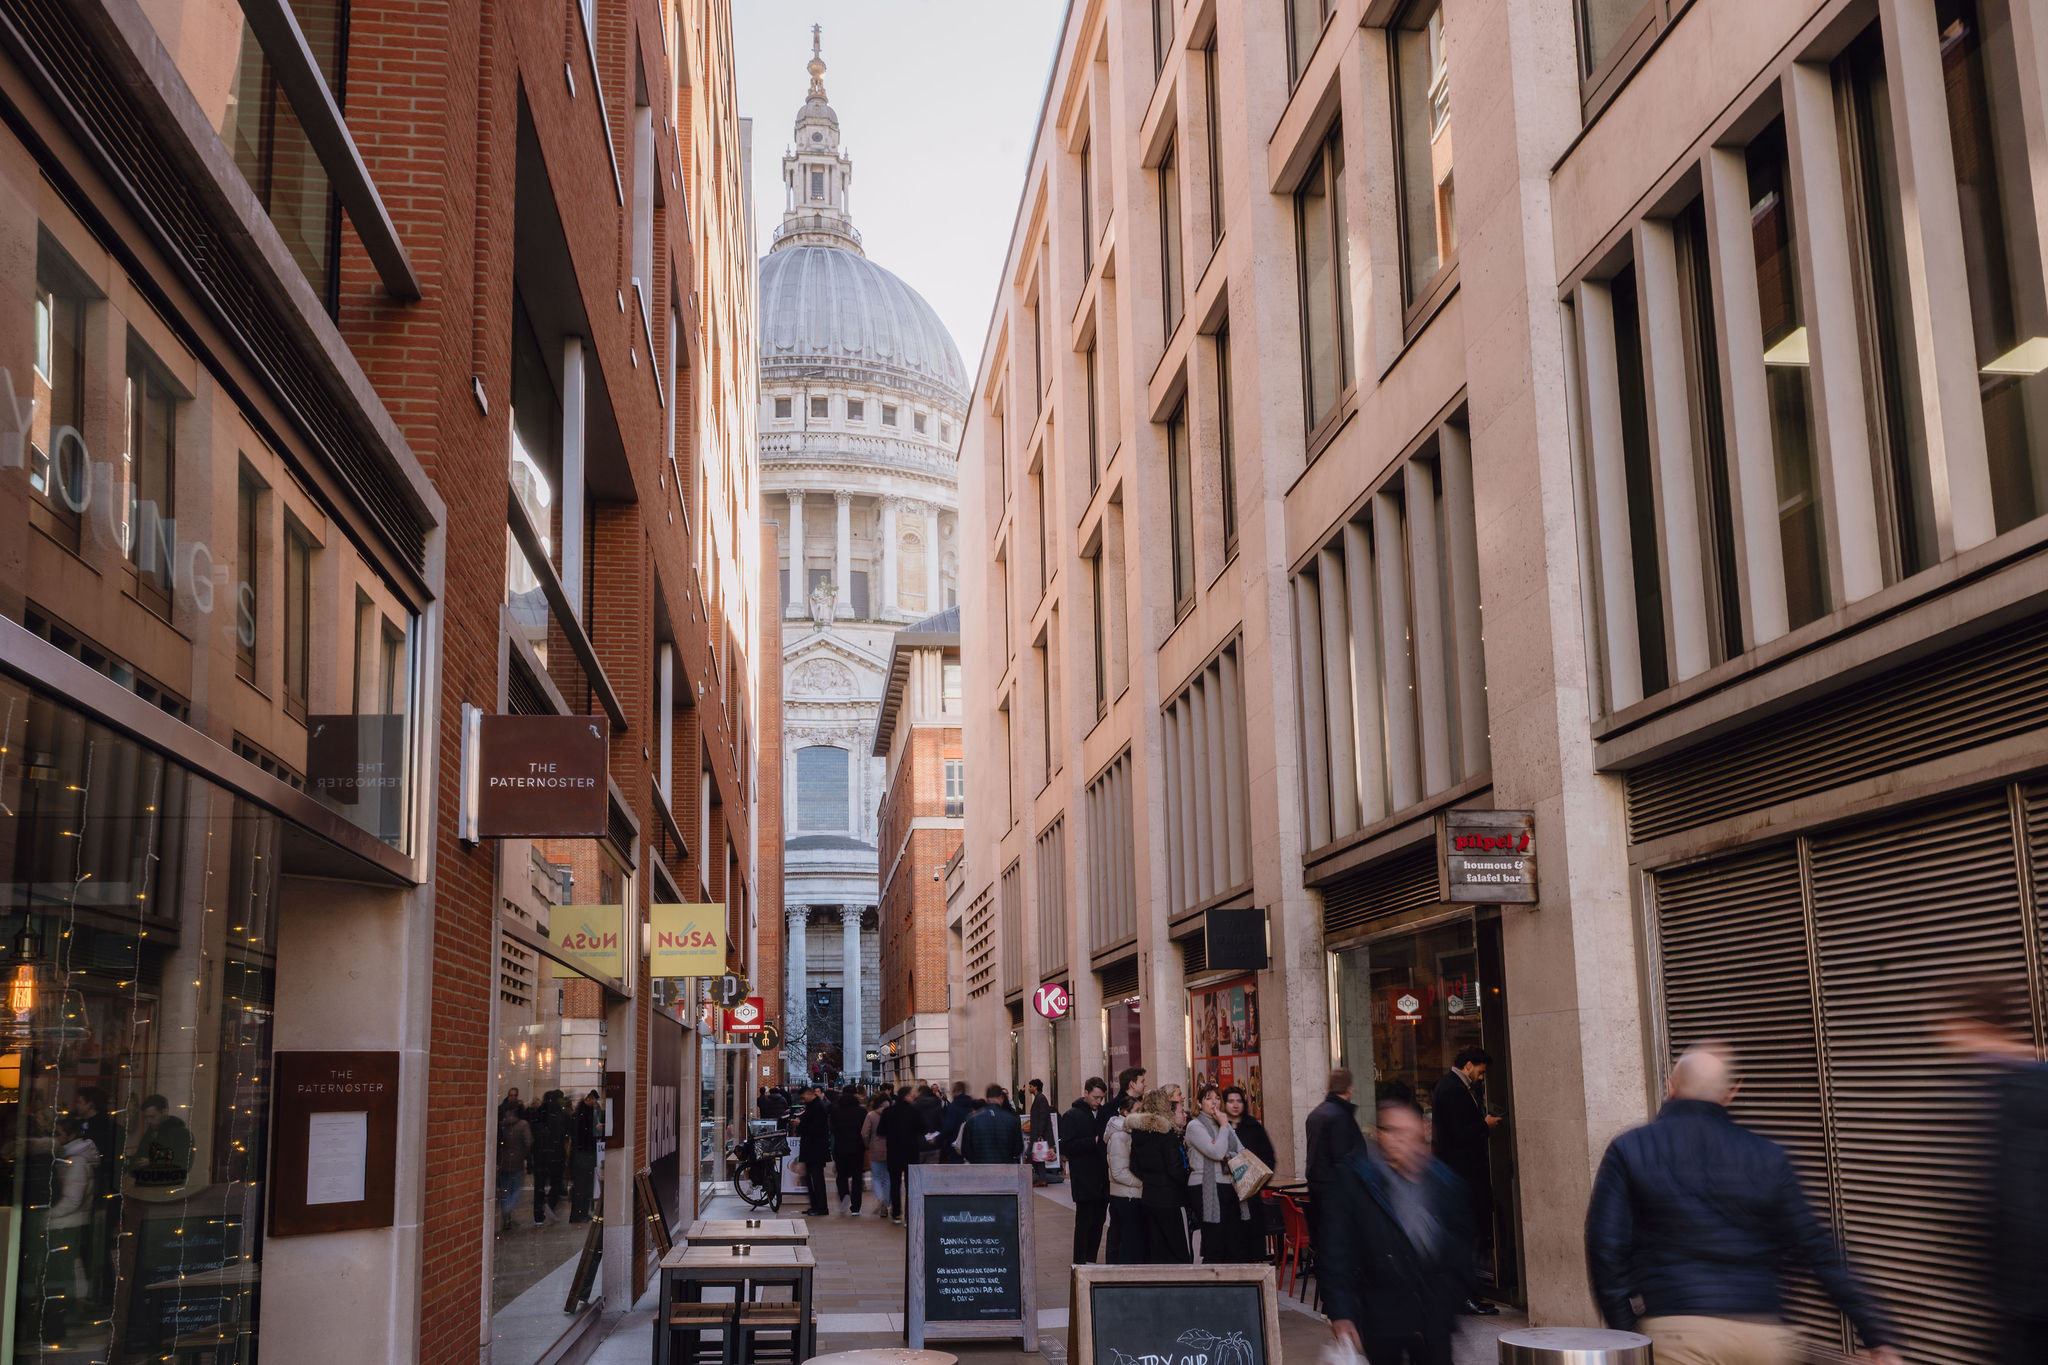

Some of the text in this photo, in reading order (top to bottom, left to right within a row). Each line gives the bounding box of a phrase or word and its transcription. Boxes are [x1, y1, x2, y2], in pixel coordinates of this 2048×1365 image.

[529, 763, 557, 773] THE
[490, 777, 595, 788] PATERNOSTER
[1455, 833, 1513, 851] pilpel
[1463, 861, 1524, 870] houmous &
[1466, 873, 1521, 882] falafel bar
[722, 976, 737, 1004] P
[1037, 988, 1067, 1014] K10
[330, 1070, 352, 1079] THE
[298, 1083, 383, 1093] PATERNOSTER
